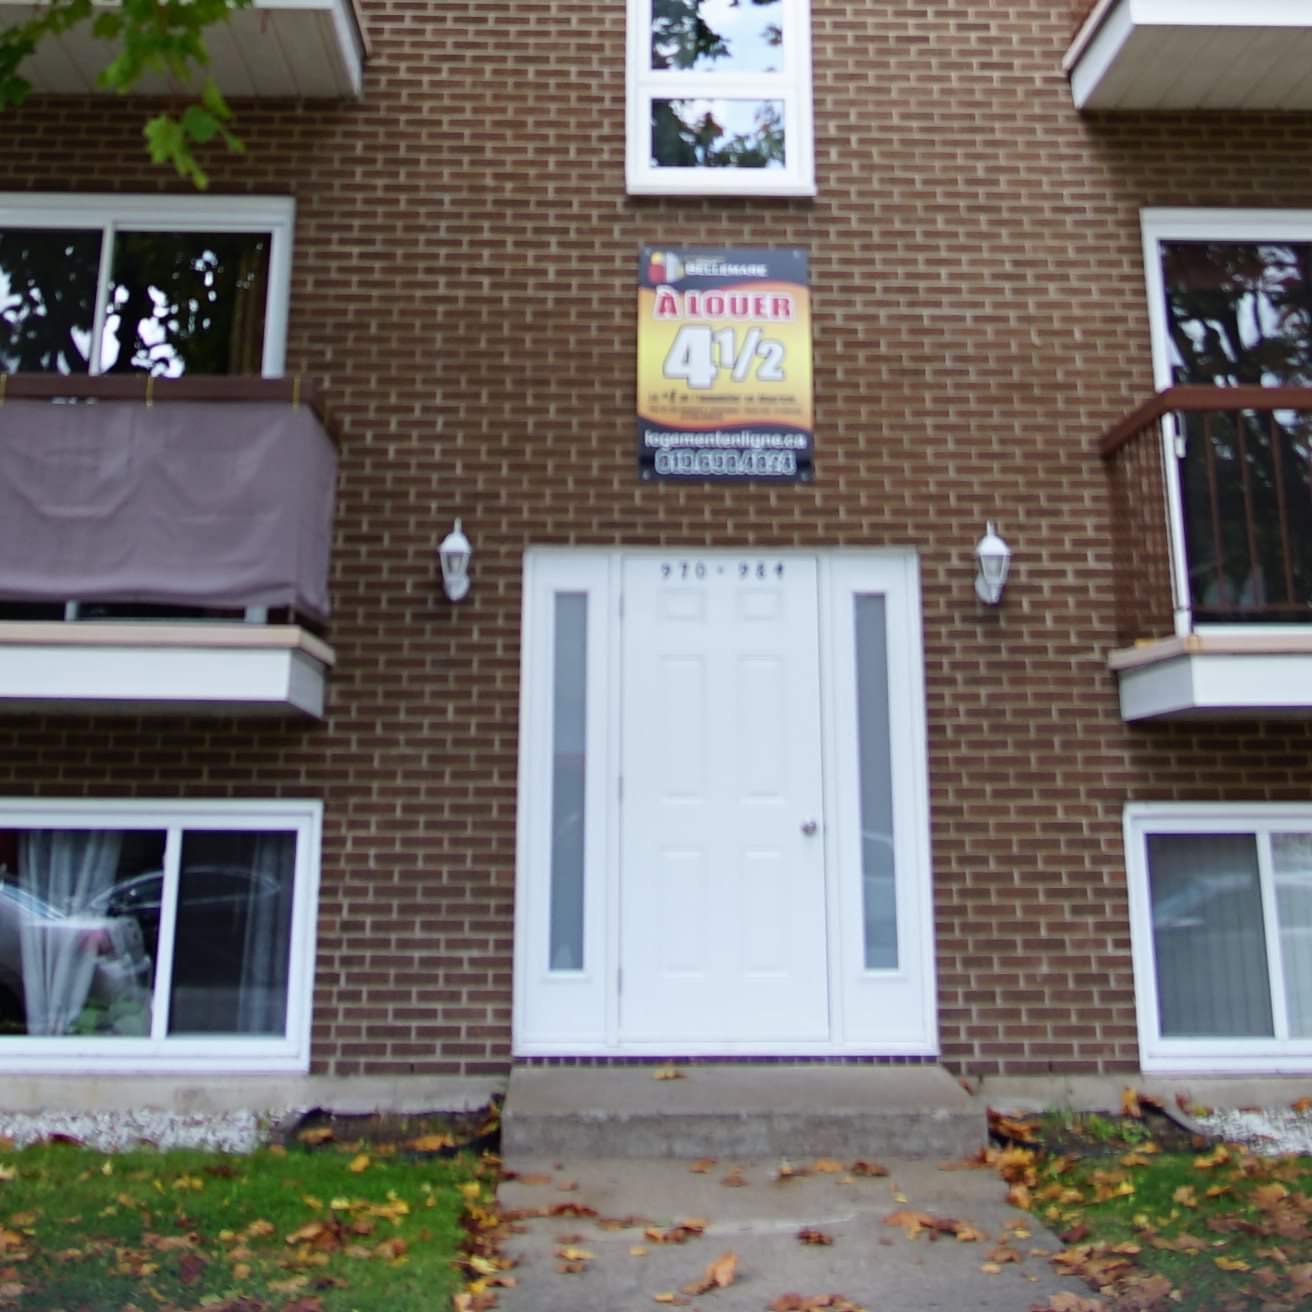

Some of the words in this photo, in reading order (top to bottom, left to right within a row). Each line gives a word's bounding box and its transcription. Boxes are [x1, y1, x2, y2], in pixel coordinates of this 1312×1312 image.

[656, 288, 679, 317] À
[687, 293, 792, 318] LOUER
[645, 431, 806, 449] logementenligne.ca
[661, 561, 705, 580] 970
